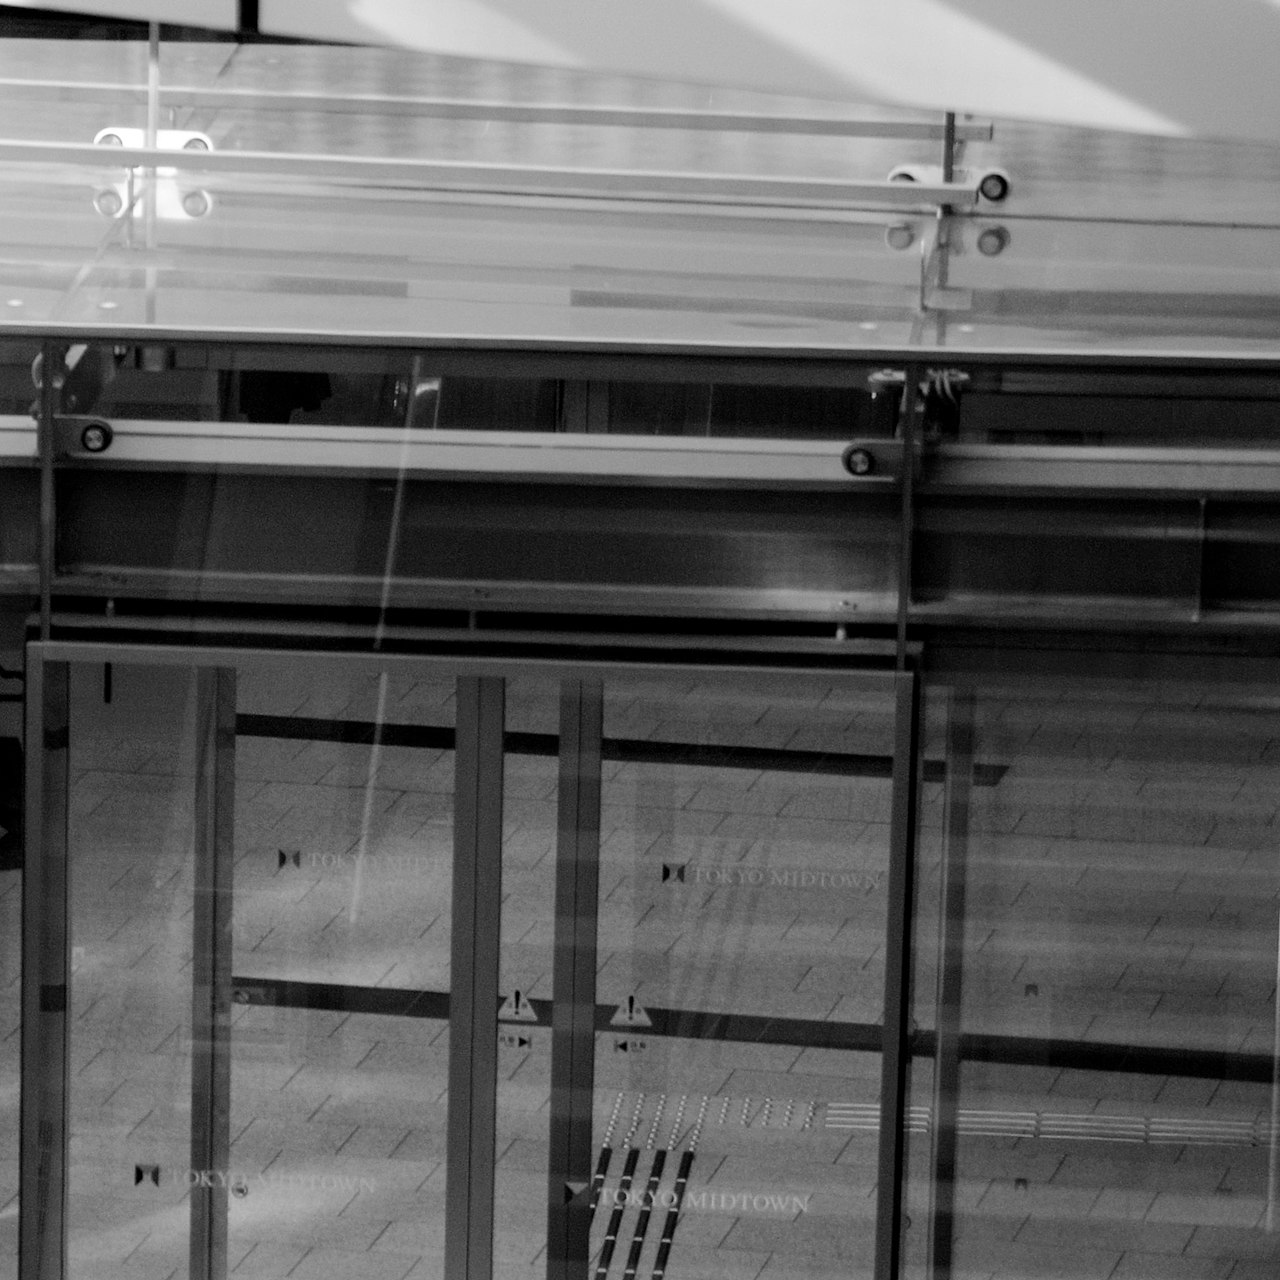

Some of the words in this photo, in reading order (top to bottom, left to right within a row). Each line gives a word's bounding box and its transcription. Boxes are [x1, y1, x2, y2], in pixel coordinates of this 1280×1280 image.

[695, 868, 763, 884] TOKYO
[771, 870, 880, 889] MIDTOWN
[598, 1187, 678, 1206] TOKYO
[689, 1192, 809, 1212] MIDTOWN
